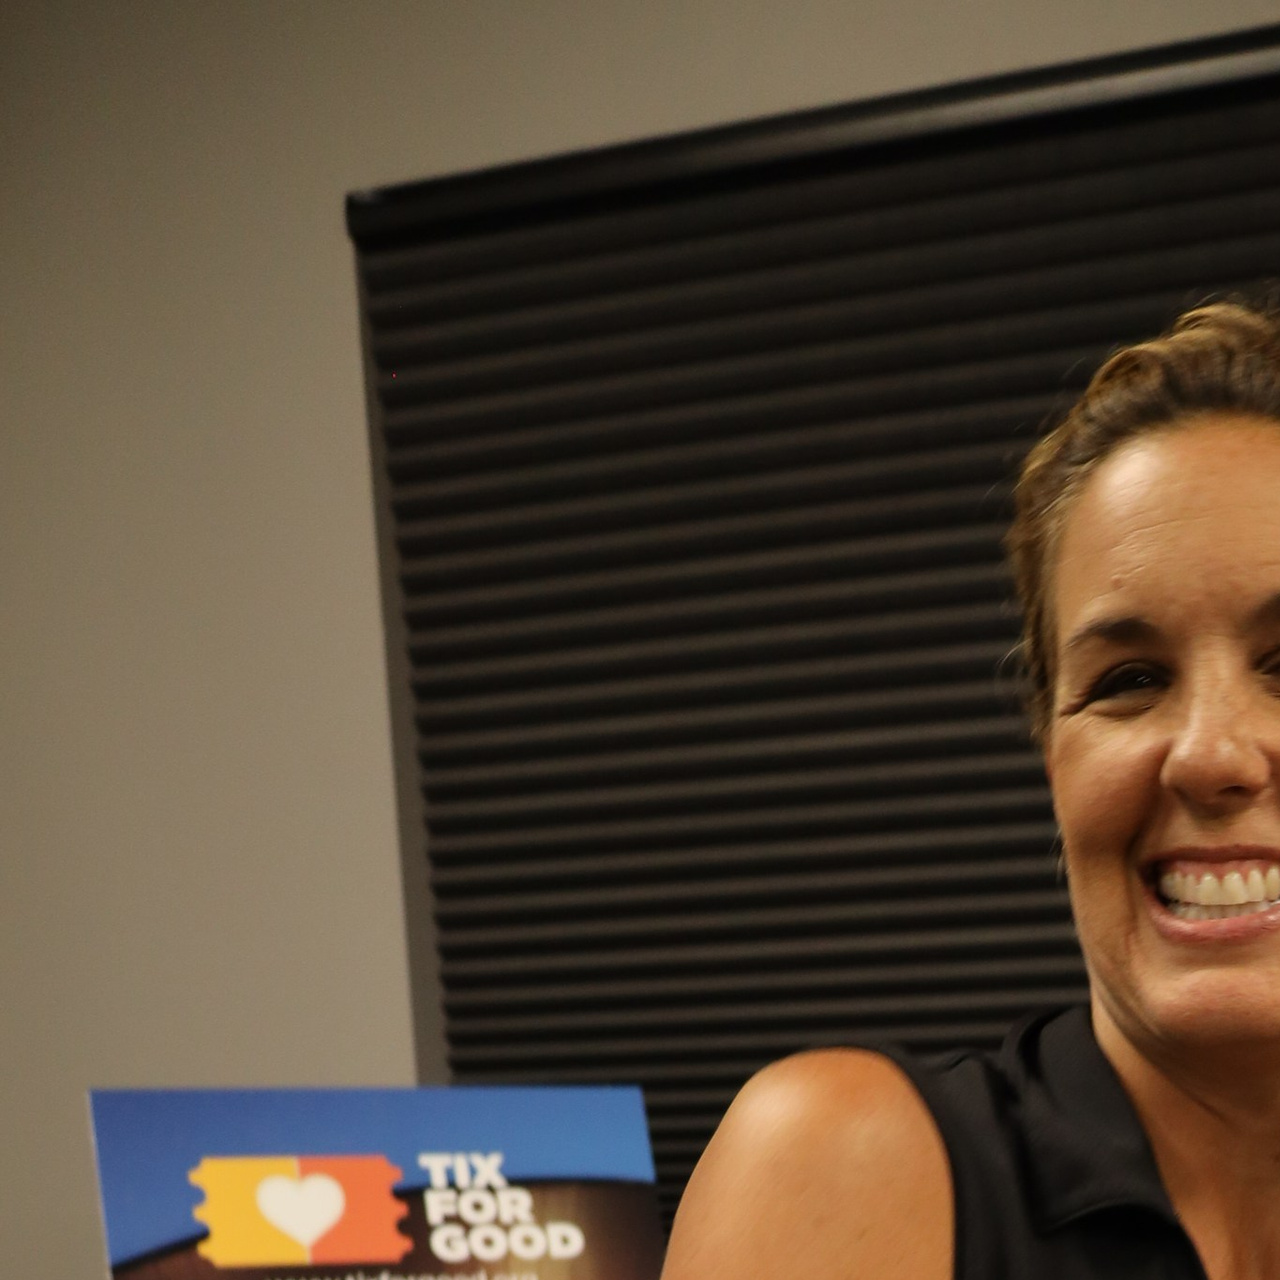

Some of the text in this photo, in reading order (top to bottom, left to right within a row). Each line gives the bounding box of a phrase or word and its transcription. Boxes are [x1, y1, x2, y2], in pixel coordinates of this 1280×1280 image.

[418, 1152, 509, 1188] TIX
[424, 1187, 535, 1226] FOR
[429, 1222, 585, 1263] GOOD
